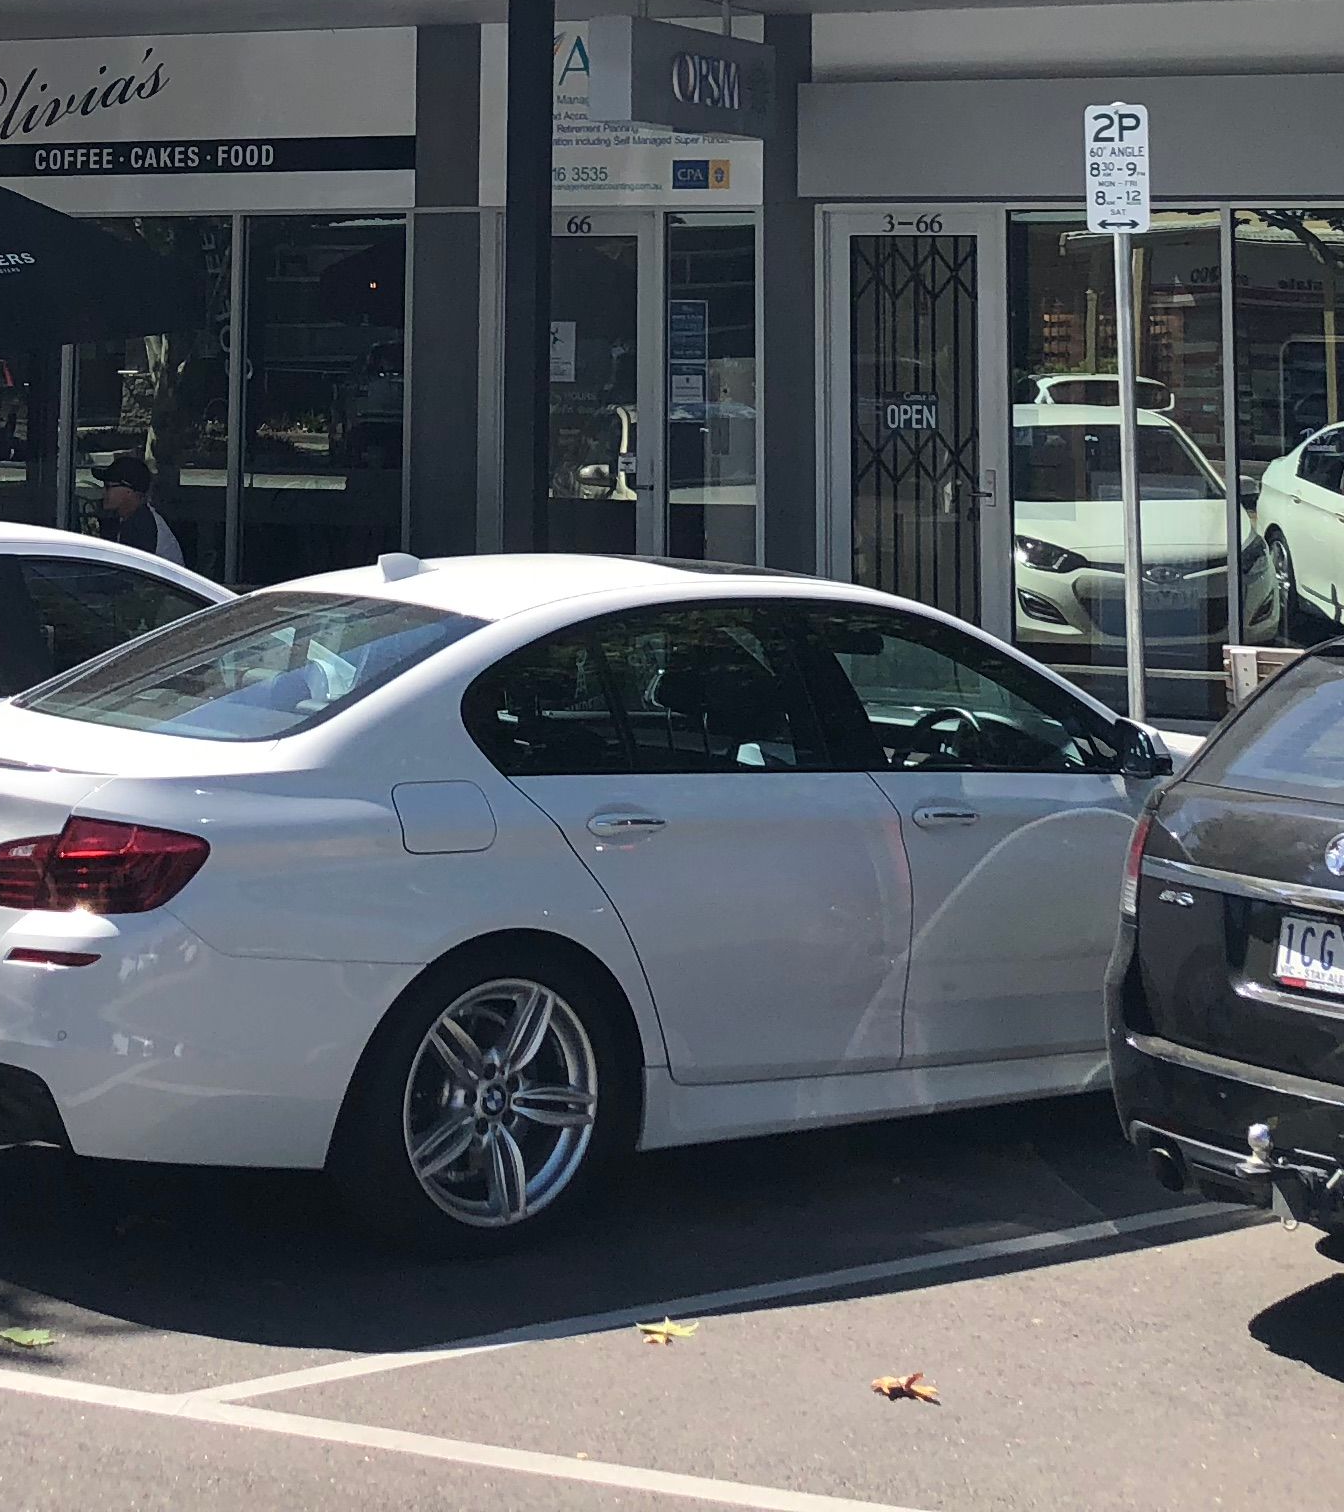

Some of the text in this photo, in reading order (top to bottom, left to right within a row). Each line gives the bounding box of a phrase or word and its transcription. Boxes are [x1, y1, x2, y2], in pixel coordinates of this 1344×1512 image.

[672, 51, 742, 111] OPSM
[1092, 113, 1141, 142] 2P
[632, 137, 672, 148] Managed
[674, 136, 700, 147] Super
[1109, 146, 1144, 157] ANGLE
[35, 144, 274, 170] COFFEE CAKES FOOD
[571, 166, 608, 182] 3535
[676, 167, 704, 181] CPA
[1110, 208, 1126, 216] SAT
[567, 215, 592, 234] 66
[882, 213, 943, 234] 3-66
[886, 404, 936, 429] OPEN
[1286, 923, 1336, 971] 1CG
[1304, 968, 1325, 981] STAY
